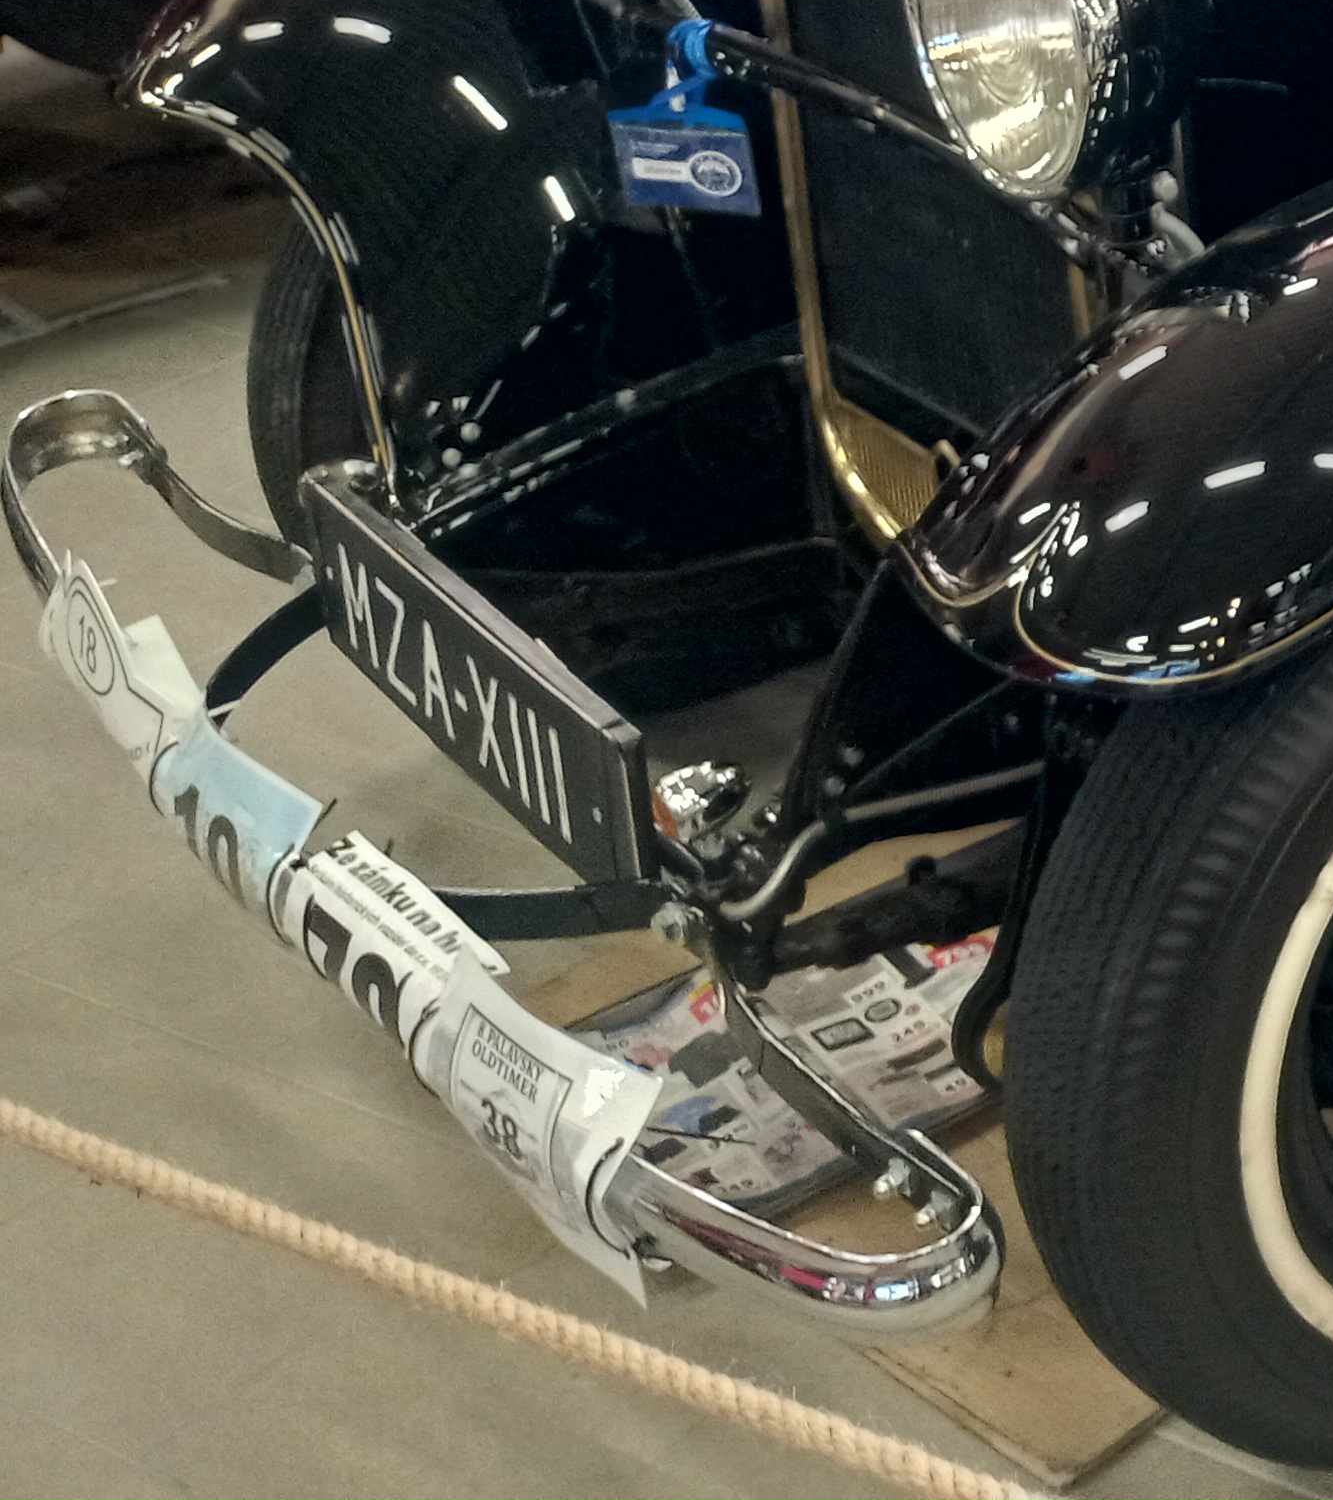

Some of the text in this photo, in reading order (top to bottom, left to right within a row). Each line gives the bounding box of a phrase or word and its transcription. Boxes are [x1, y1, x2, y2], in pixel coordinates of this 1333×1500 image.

[78, 615, 97, 674] 18
[338, 542, 573, 846] MZA-XIII
[325, 837, 358, 865] Ze
[348, 861, 417, 913] zámku
[405, 910, 441, 937] na
[472, 1039, 538, 1104] OLDTIMER
[481, 1098, 521, 1160] 38
